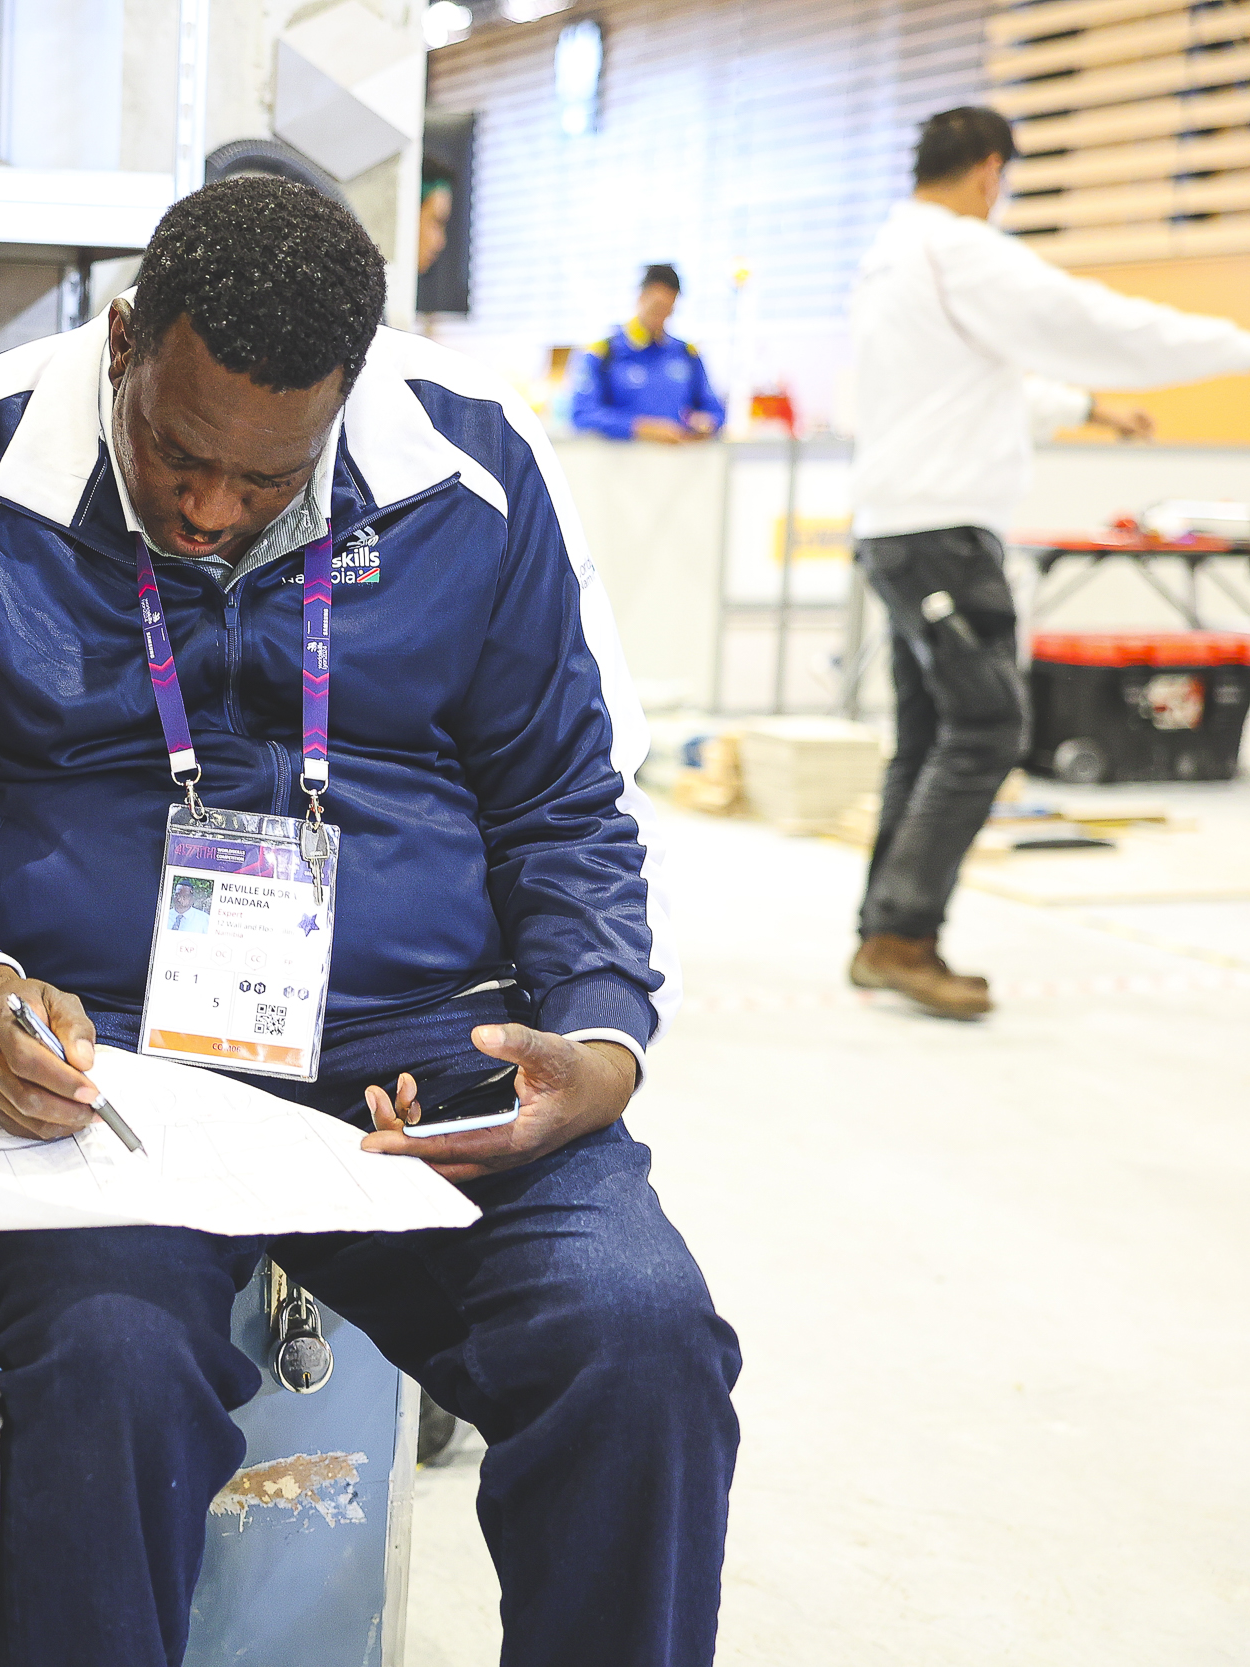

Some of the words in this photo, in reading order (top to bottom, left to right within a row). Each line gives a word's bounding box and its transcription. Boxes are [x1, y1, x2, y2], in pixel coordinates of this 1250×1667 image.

[221, 882, 260, 896] NEVILLE
[219, 895, 270, 909] UANDARA
[217, 908, 243, 919] Expert
[212, 997, 220, 1008] 5
